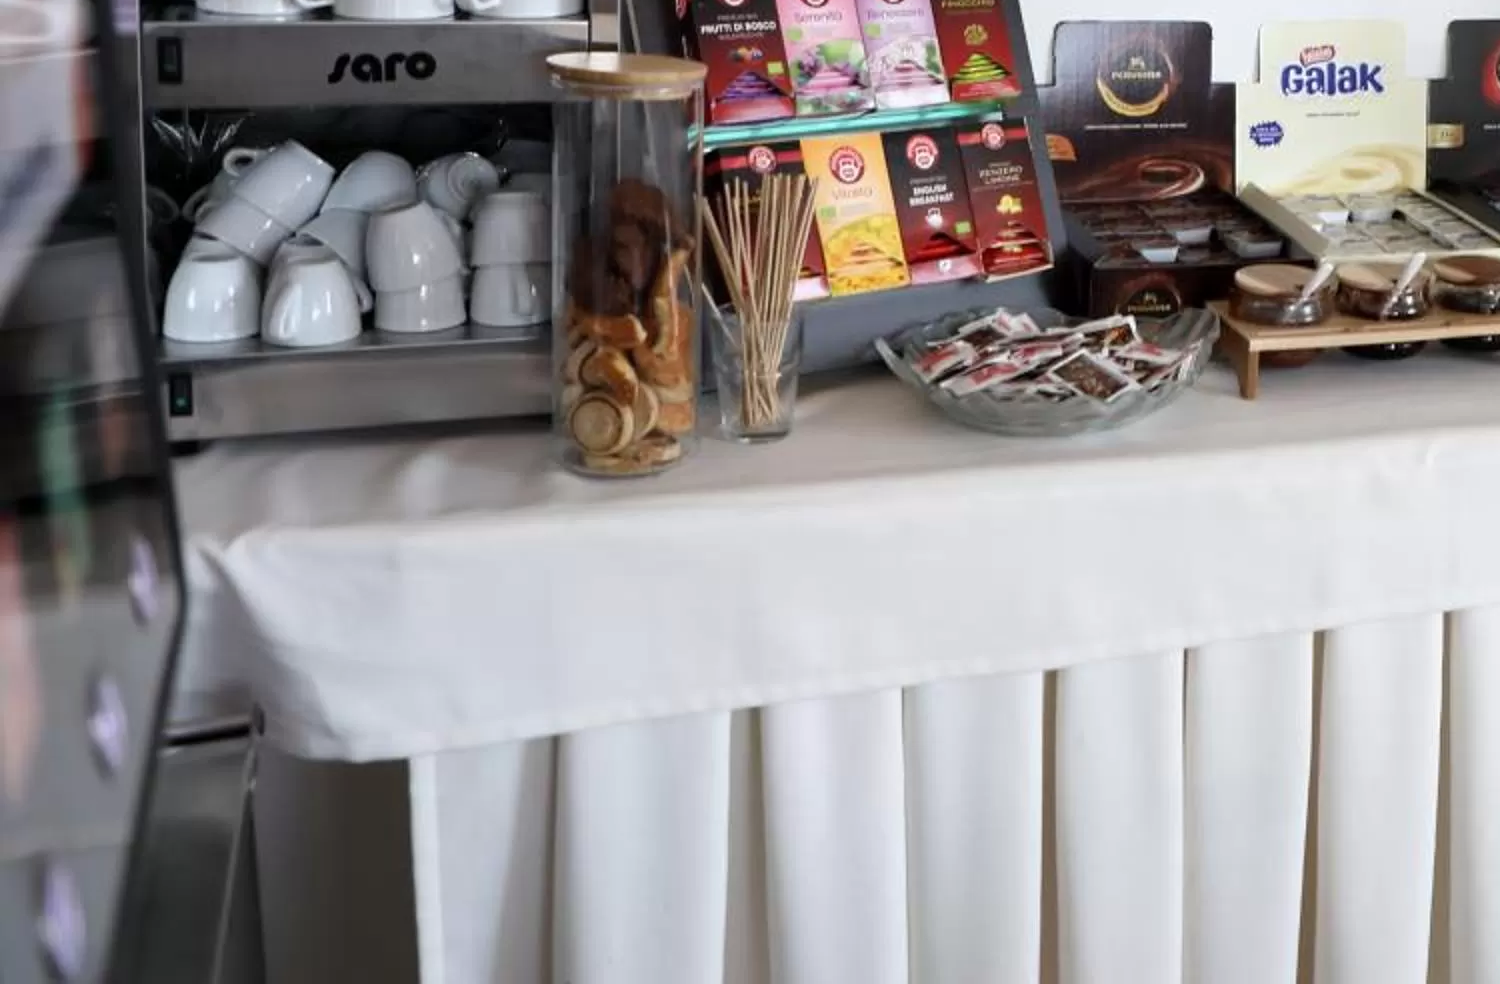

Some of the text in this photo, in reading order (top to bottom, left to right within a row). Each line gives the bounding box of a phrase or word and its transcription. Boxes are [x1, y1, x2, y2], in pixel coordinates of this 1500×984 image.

[701, 20, 777, 34] FRUTTI DI BOSCO
[327, 50, 437, 84] saro
[1281, 62, 1384, 96] Galak
